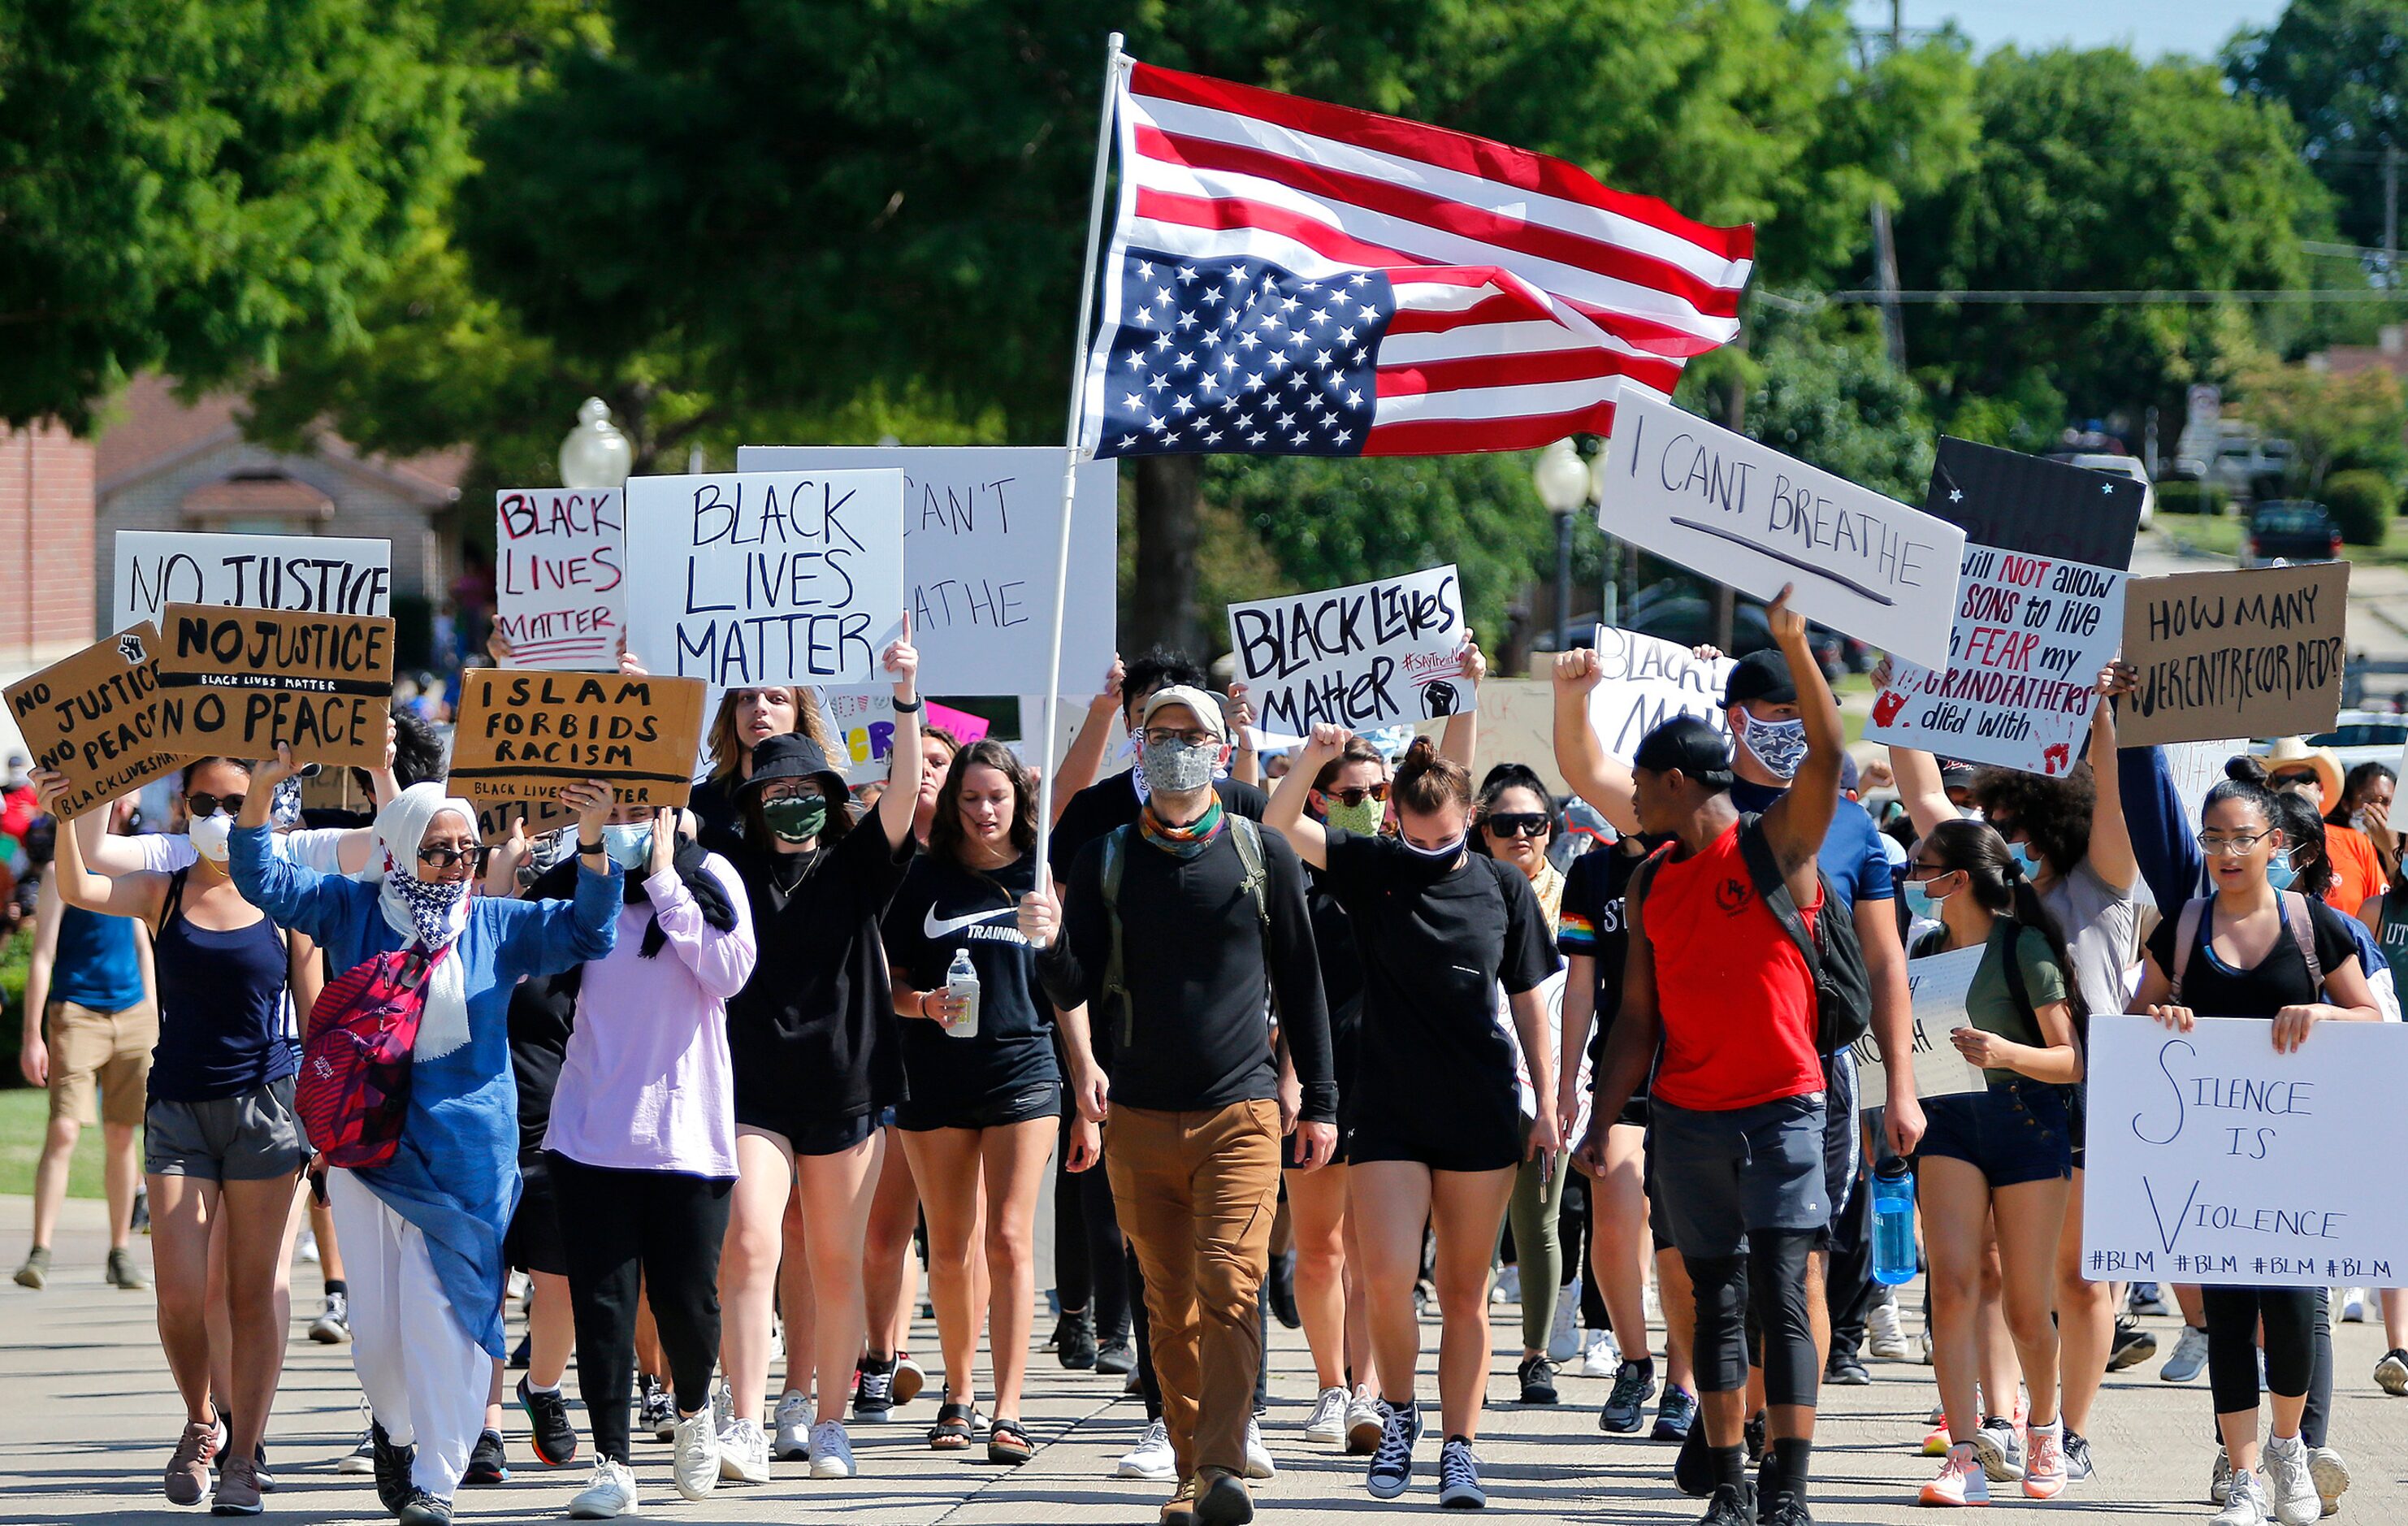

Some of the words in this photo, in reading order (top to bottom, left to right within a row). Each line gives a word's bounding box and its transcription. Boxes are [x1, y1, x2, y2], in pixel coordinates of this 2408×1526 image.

[500, 494, 621, 540] BLACK
[693, 481, 865, 553] BLACK
[903, 475, 1016, 535] AN'T
[1631, 415, 1644, 478] I
[1661, 433, 1756, 514] CANT
[1768, 473, 1934, 587] BREATHE
[130, 553, 202, 613] NO
[505, 546, 621, 594] LIVES
[686, 548, 854, 614] LIVES
[1998, 555, 2051, 588] NOT
[2052, 566, 2116, 598] allow
[500, 607, 616, 641] MATTER
[1960, 583, 2021, 623] SONS
[2024, 596, 2051, 628] to
[2055, 600, 2101, 637] live
[2150, 596, 2224, 641] HOW
[2235, 583, 2318, 630] MANY
[178, 618, 243, 664] NO
[248, 621, 386, 671] JUSTICE
[677, 613, 873, 687] MATTER
[1234, 596, 1365, 679] BLACK
[1964, 626, 2040, 671] FEAR
[2039, 646, 2082, 681] my
[15, 683, 51, 717] NO
[201, 674, 237, 686] BLACK
[244, 675, 276, 687] LIVES
[285, 678, 336, 691] MATTER
[482, 678, 651, 707] ISLAM
[1924, 666, 2096, 716] GRANDFATHERS
[162, 693, 225, 737] NO
[245, 692, 366, 750] PEACE
[486, 713, 658, 742] FORBIDS
[1921, 701, 1972, 734] died
[41, 739, 76, 772] NO
[495, 740, 632, 766] RACISM
[474, 782, 515, 796] BLACK
[524, 785, 565, 798] LIVE
[968, 924, 1029, 945] TRAINING
[2132, 1039, 2315, 1144] SILENCE
[2226, 1127, 2276, 1160] IS
[2142, 1176, 2348, 1254] VIOLENCE
[2088, 1250, 2155, 1272] #BLM
[2174, 1254, 2237, 1275] #BLM
[2250, 1256, 2315, 1276] #BLM
[2326, 1257, 2392, 1278] #BLM
